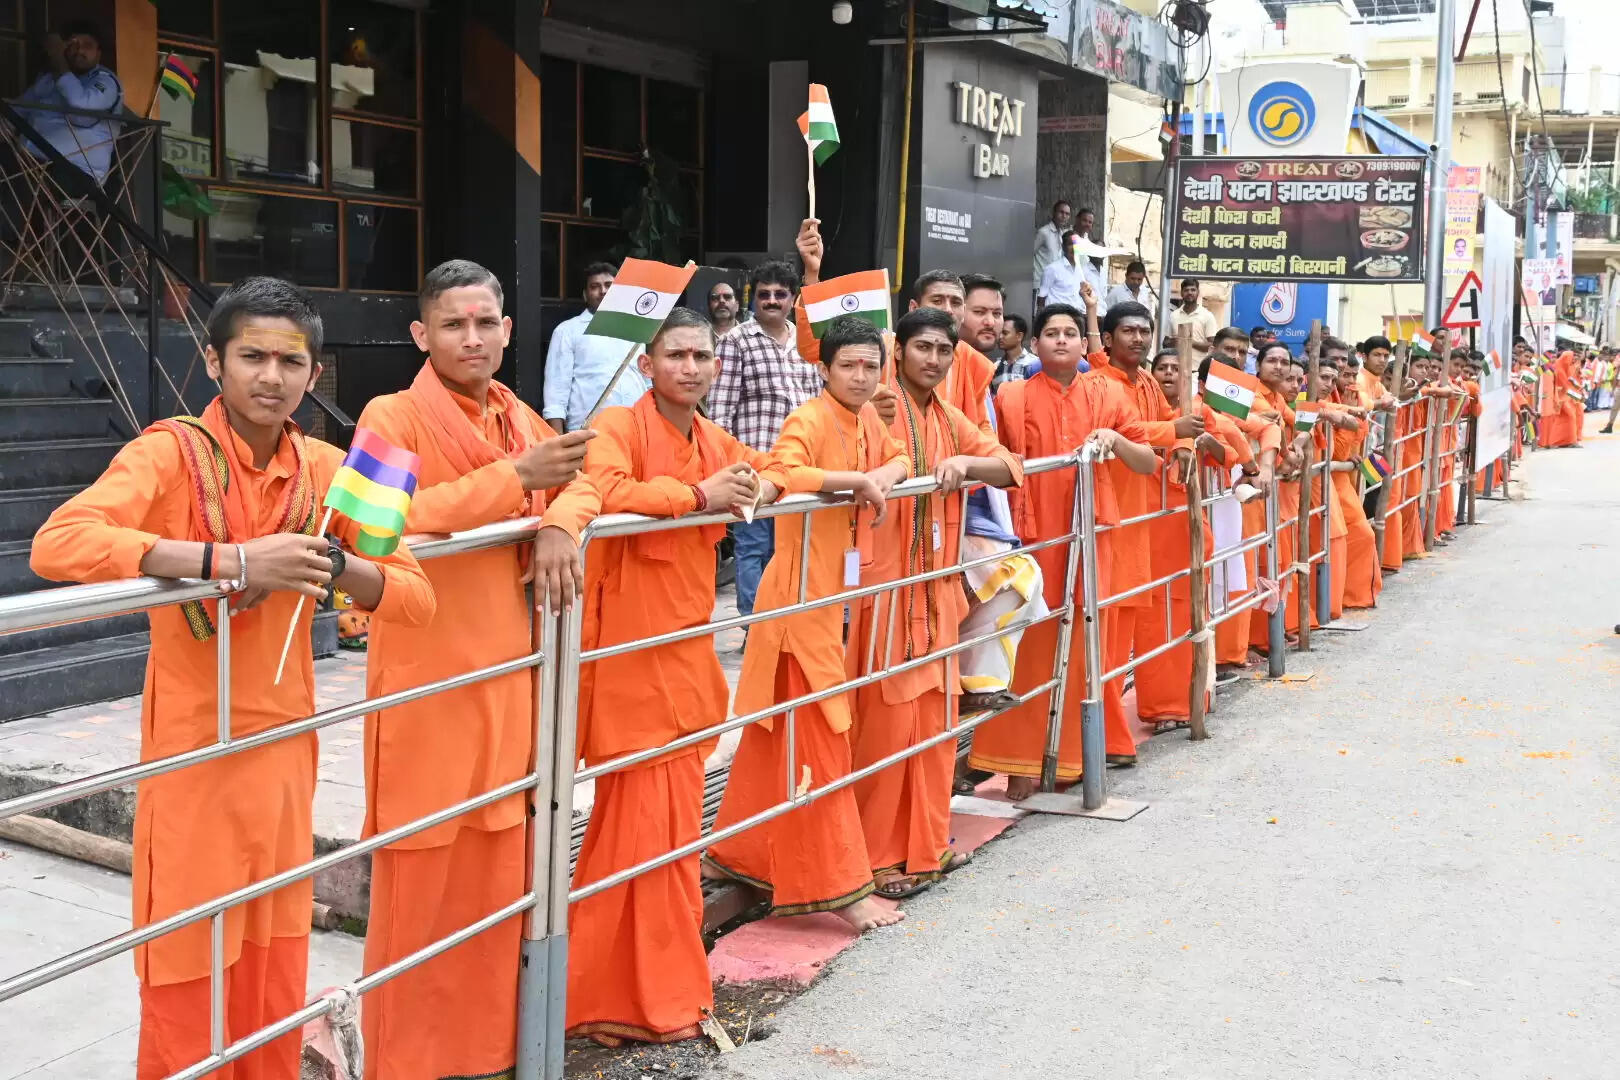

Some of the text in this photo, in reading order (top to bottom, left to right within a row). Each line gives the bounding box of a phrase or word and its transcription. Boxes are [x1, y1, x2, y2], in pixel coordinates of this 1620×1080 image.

[957, 81, 1026, 146] TREAT
[978, 143, 1010, 178] BAR
[1266, 162, 1332, 176] TREAT
[1184, 175, 1224, 201] देशी
[1228, 181, 1273, 201] मटन
[1277, 181, 1370, 203] झारखण्ड
[1182, 206, 1281, 225] देशी फिश करी
[1180, 230, 1209, 248] देशी
[1212, 234, 1245, 249] मटन
[1178, 253, 1208, 272] देशी
[1211, 258, 1244, 273] मटन
[1285, 328, 1306, 337] Sure
